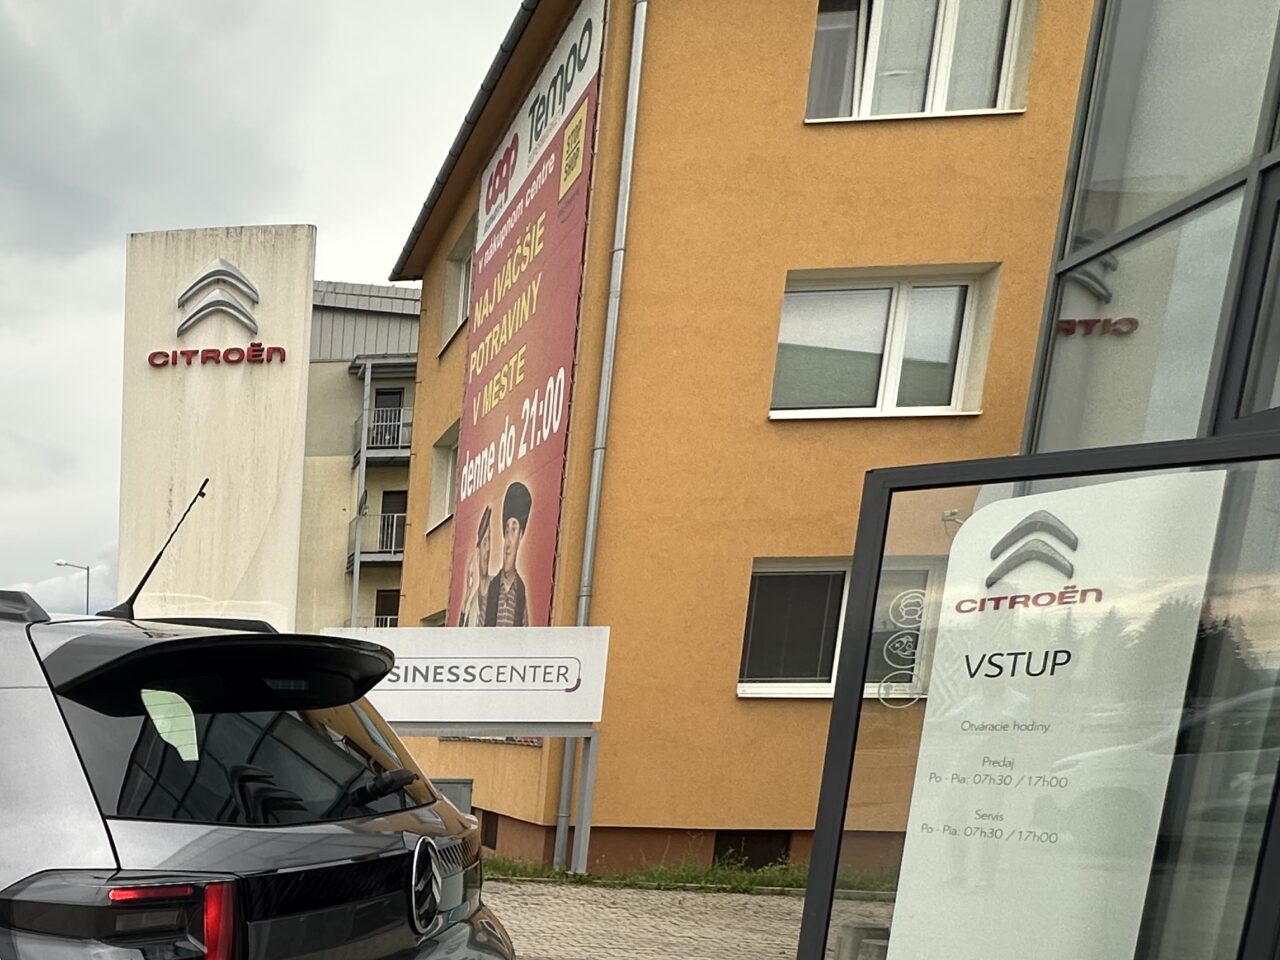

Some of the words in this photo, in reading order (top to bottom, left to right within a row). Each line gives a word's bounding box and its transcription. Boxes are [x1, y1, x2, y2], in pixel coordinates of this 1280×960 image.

[528, 17, 593, 153] Tempo
[525, 152, 555, 208] centre
[473, 210, 547, 333] NAJVÄČŠIE
[469, 271, 543, 384] POTRAVINY
[472, 395, 481, 426] V
[482, 345, 527, 418] MESTE
[460, 442, 495, 502] denne
[498, 415, 516, 472] do
[517, 367, 566, 459] 21:00
[387, 664, 570, 684] SINESSCENTER
[964, 649, 1073, 679] VSTUP
[1013, 720, 1051, 734] hodiny
[982, 756, 1015, 770] Predaj
[928, 772, 942, 784] Po
[972, 774, 1013, 786] 07h30
[1027, 776, 1069, 789] 17h00
[974, 809, 1005, 822] Servis
[920, 823, 934, 834] Po
[963, 826, 1004, 840] 07h30
[1018, 830, 1059, 844] 17h00
